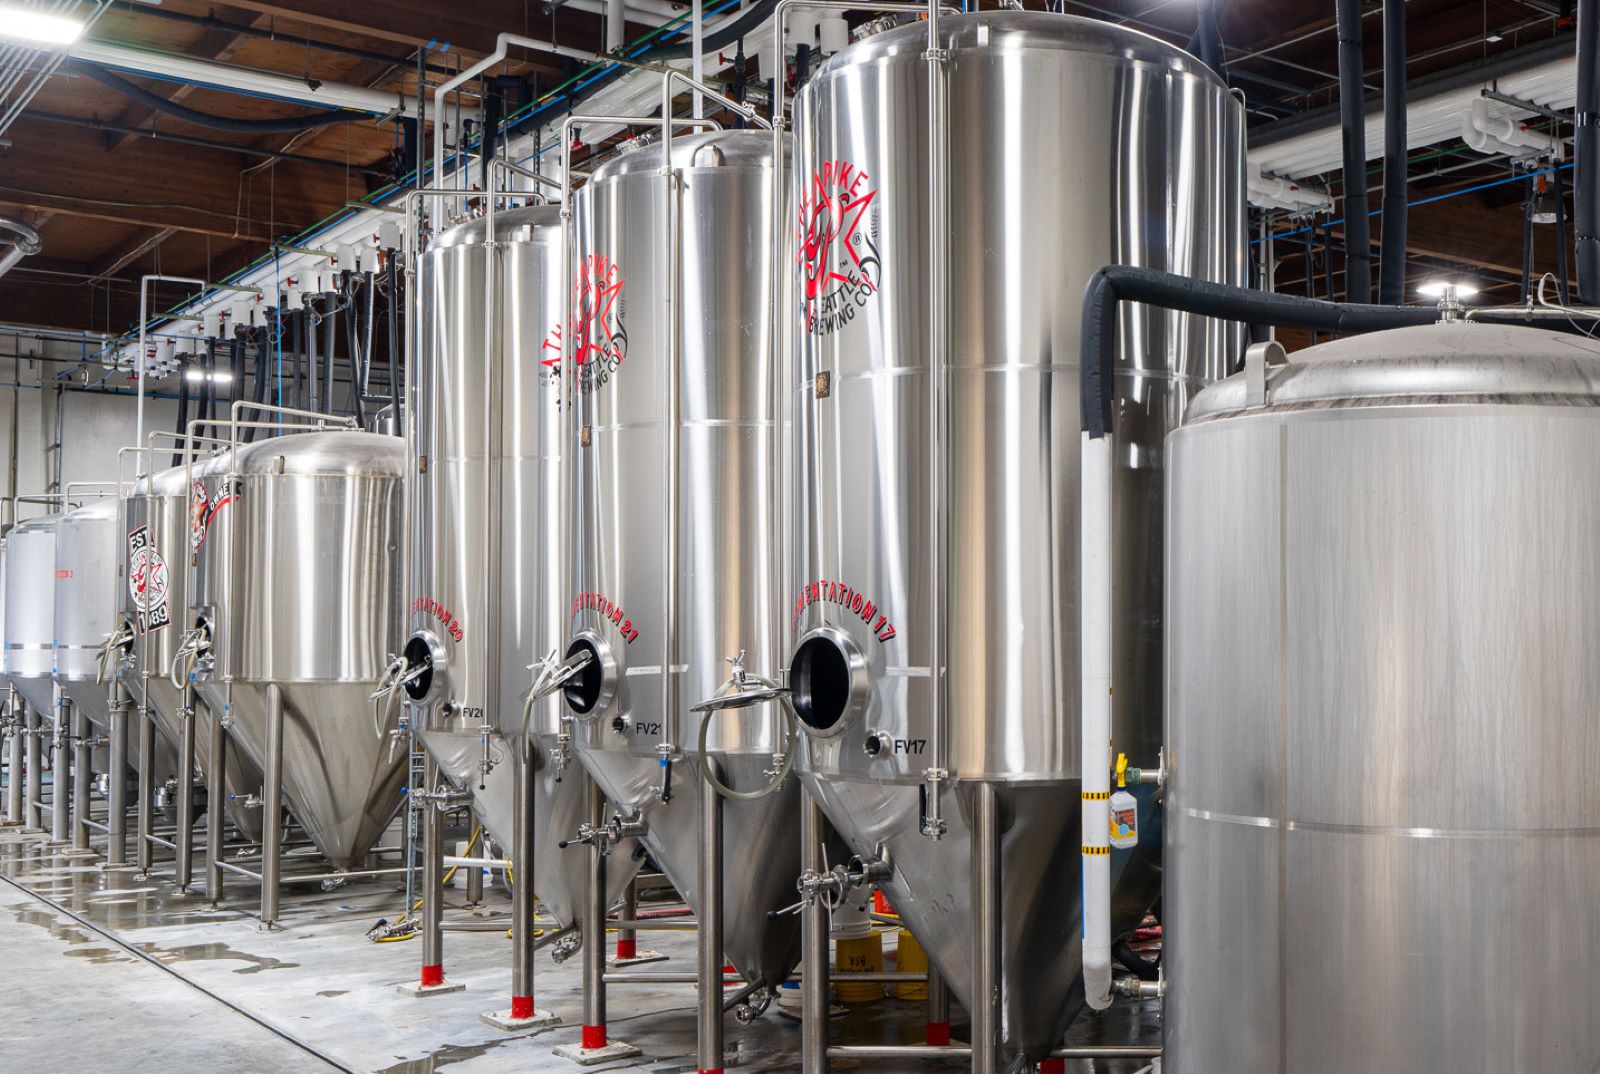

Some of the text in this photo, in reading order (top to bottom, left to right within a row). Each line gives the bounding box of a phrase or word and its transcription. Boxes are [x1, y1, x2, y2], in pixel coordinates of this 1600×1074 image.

[823, 160, 869, 198] PIKE
[588, 254, 619, 284] PIKE
[814, 270, 860, 314] EATTLE
[139, 606, 167, 632] 189
[448, 620, 464, 643] 20
[620, 618, 639, 645] 21
[874, 614, 897, 643] 17
[894, 739, 927, 754] FV17
